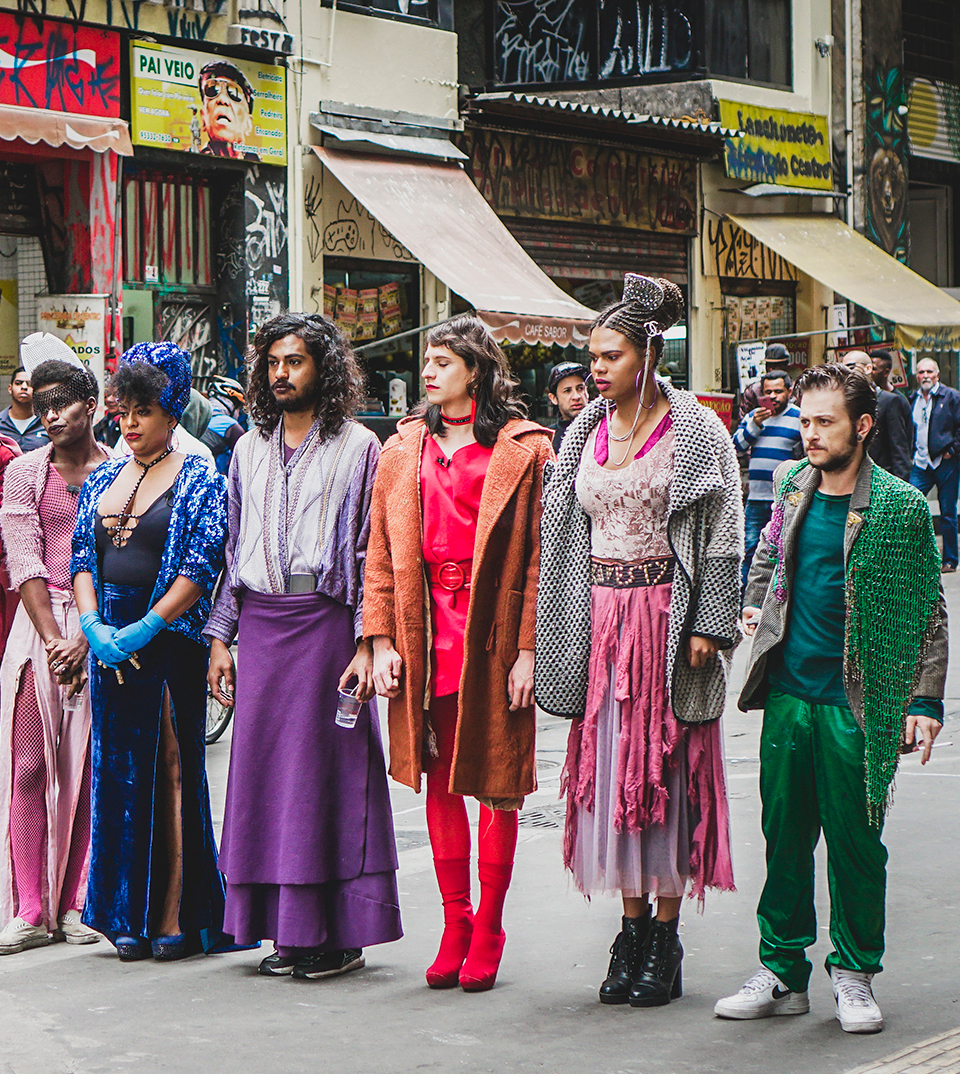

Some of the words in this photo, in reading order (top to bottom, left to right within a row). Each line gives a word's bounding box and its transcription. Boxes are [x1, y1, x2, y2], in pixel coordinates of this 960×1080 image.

[140, 54, 161, 75] PAI
[164, 58, 195, 80] VEIO
[253, 89, 283, 101] Serralheiro
[260, 108, 283, 119] Pedreiro
[255, 126, 284, 139] Encanador
[233, 142, 259, 154] Reformas
[259, 146, 268, 155] em
[268, 146, 284, 157] Geral
[524, 322, 543, 338] CAFÉ
[543, 325, 568, 339] SABOR
